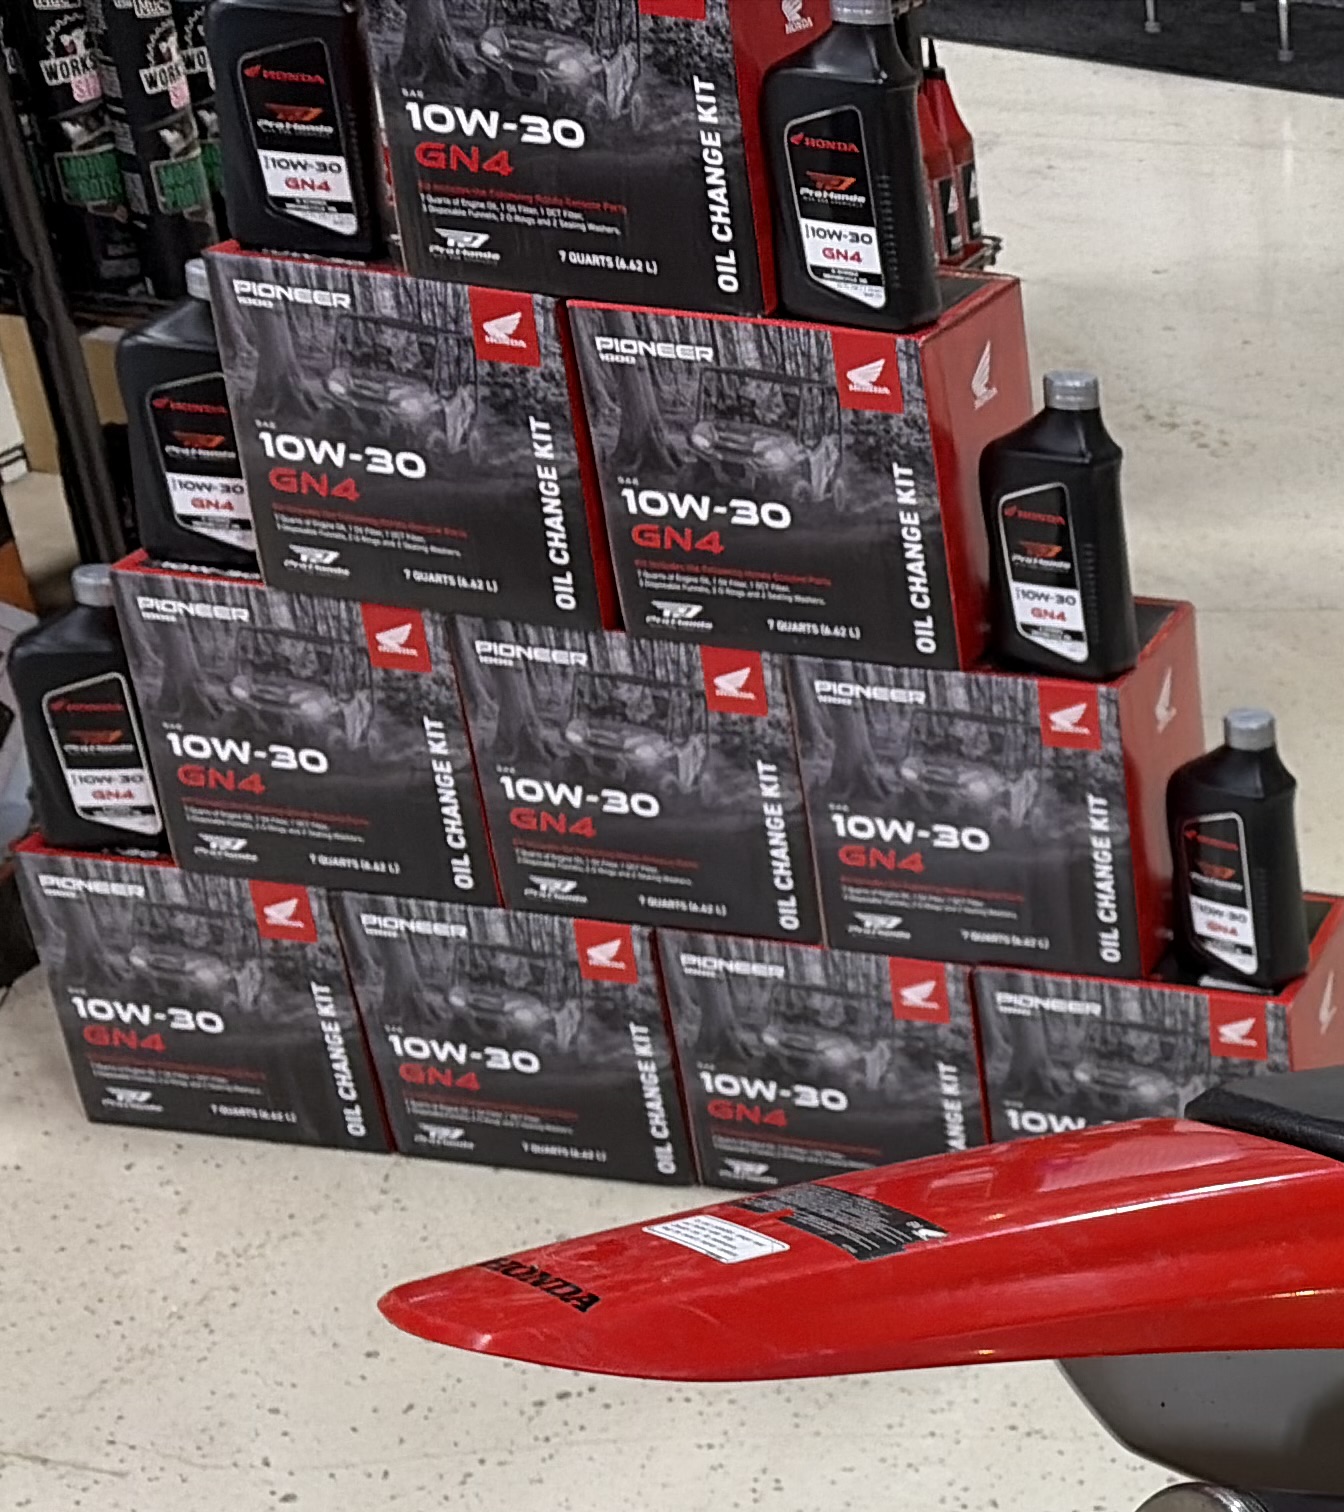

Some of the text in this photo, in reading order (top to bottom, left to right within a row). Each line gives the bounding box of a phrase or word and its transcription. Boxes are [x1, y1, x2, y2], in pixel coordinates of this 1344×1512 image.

[263, 70, 325, 85] HONDA
[405, 102, 586, 149] 10W-30
[415, 142, 514, 177] GN4
[804, 137, 860, 153] HONDA
[271, 157, 342, 174] 10W-30
[285, 177, 331, 192] GN4
[694, 75, 739, 293] OIL CHANGE KIT
[810, 227, 873, 246] 10W-30
[558, 249, 567, 263] 7
[568, 251, 614, 269] QUARTS
[822, 247, 863, 264] GN4
[233, 279, 351, 310] PIONEER
[595, 336, 713, 363] PIONEER
[258, 431, 427, 479] 10W-30
[268, 467, 360, 501] GN4
[529, 416, 577, 611] OIL CHANGE KIT
[621, 487, 792, 530] 10W-30
[631, 523, 725, 555] GN4
[892, 462, 937, 655] OIL CHANGE KIT
[137, 595, 250, 622] PIONEER
[475, 640, 588, 667] PIONEER
[814, 680, 926, 706] PIONEER
[167, 732, 328, 774] 10W-30
[177, 764, 266, 795] GN4
[423, 715, 475, 891] OIL CHANGE KIT
[500, 775, 661, 818] 10W-30
[509, 807, 597, 839] GN4
[831, 812, 991, 853] 10W-30
[756, 758, 800, 931] OIL CHANGE KIT
[838, 844, 926, 875] GN4
[1086, 792, 1122, 964] OIL CHANGE KIT
[680, 952, 785, 979] PIONEER
[71, 996, 225, 1034] 10W-30
[995, 992, 1103, 1017] PIONEER
[83, 1023, 166, 1052] GN4
[310, 981, 367, 1138] OIL CHANGE KIT
[388, 1034, 541, 1074] 10W-30
[399, 1062, 481, 1092] GN4
[700, 1070, 849, 1112] 10W-30
[936, 1060, 959, 1097] KIT
[629, 1021, 677, 1176] OIL CHANGE KIT
[707, 1099, 788, 1128] GN4
